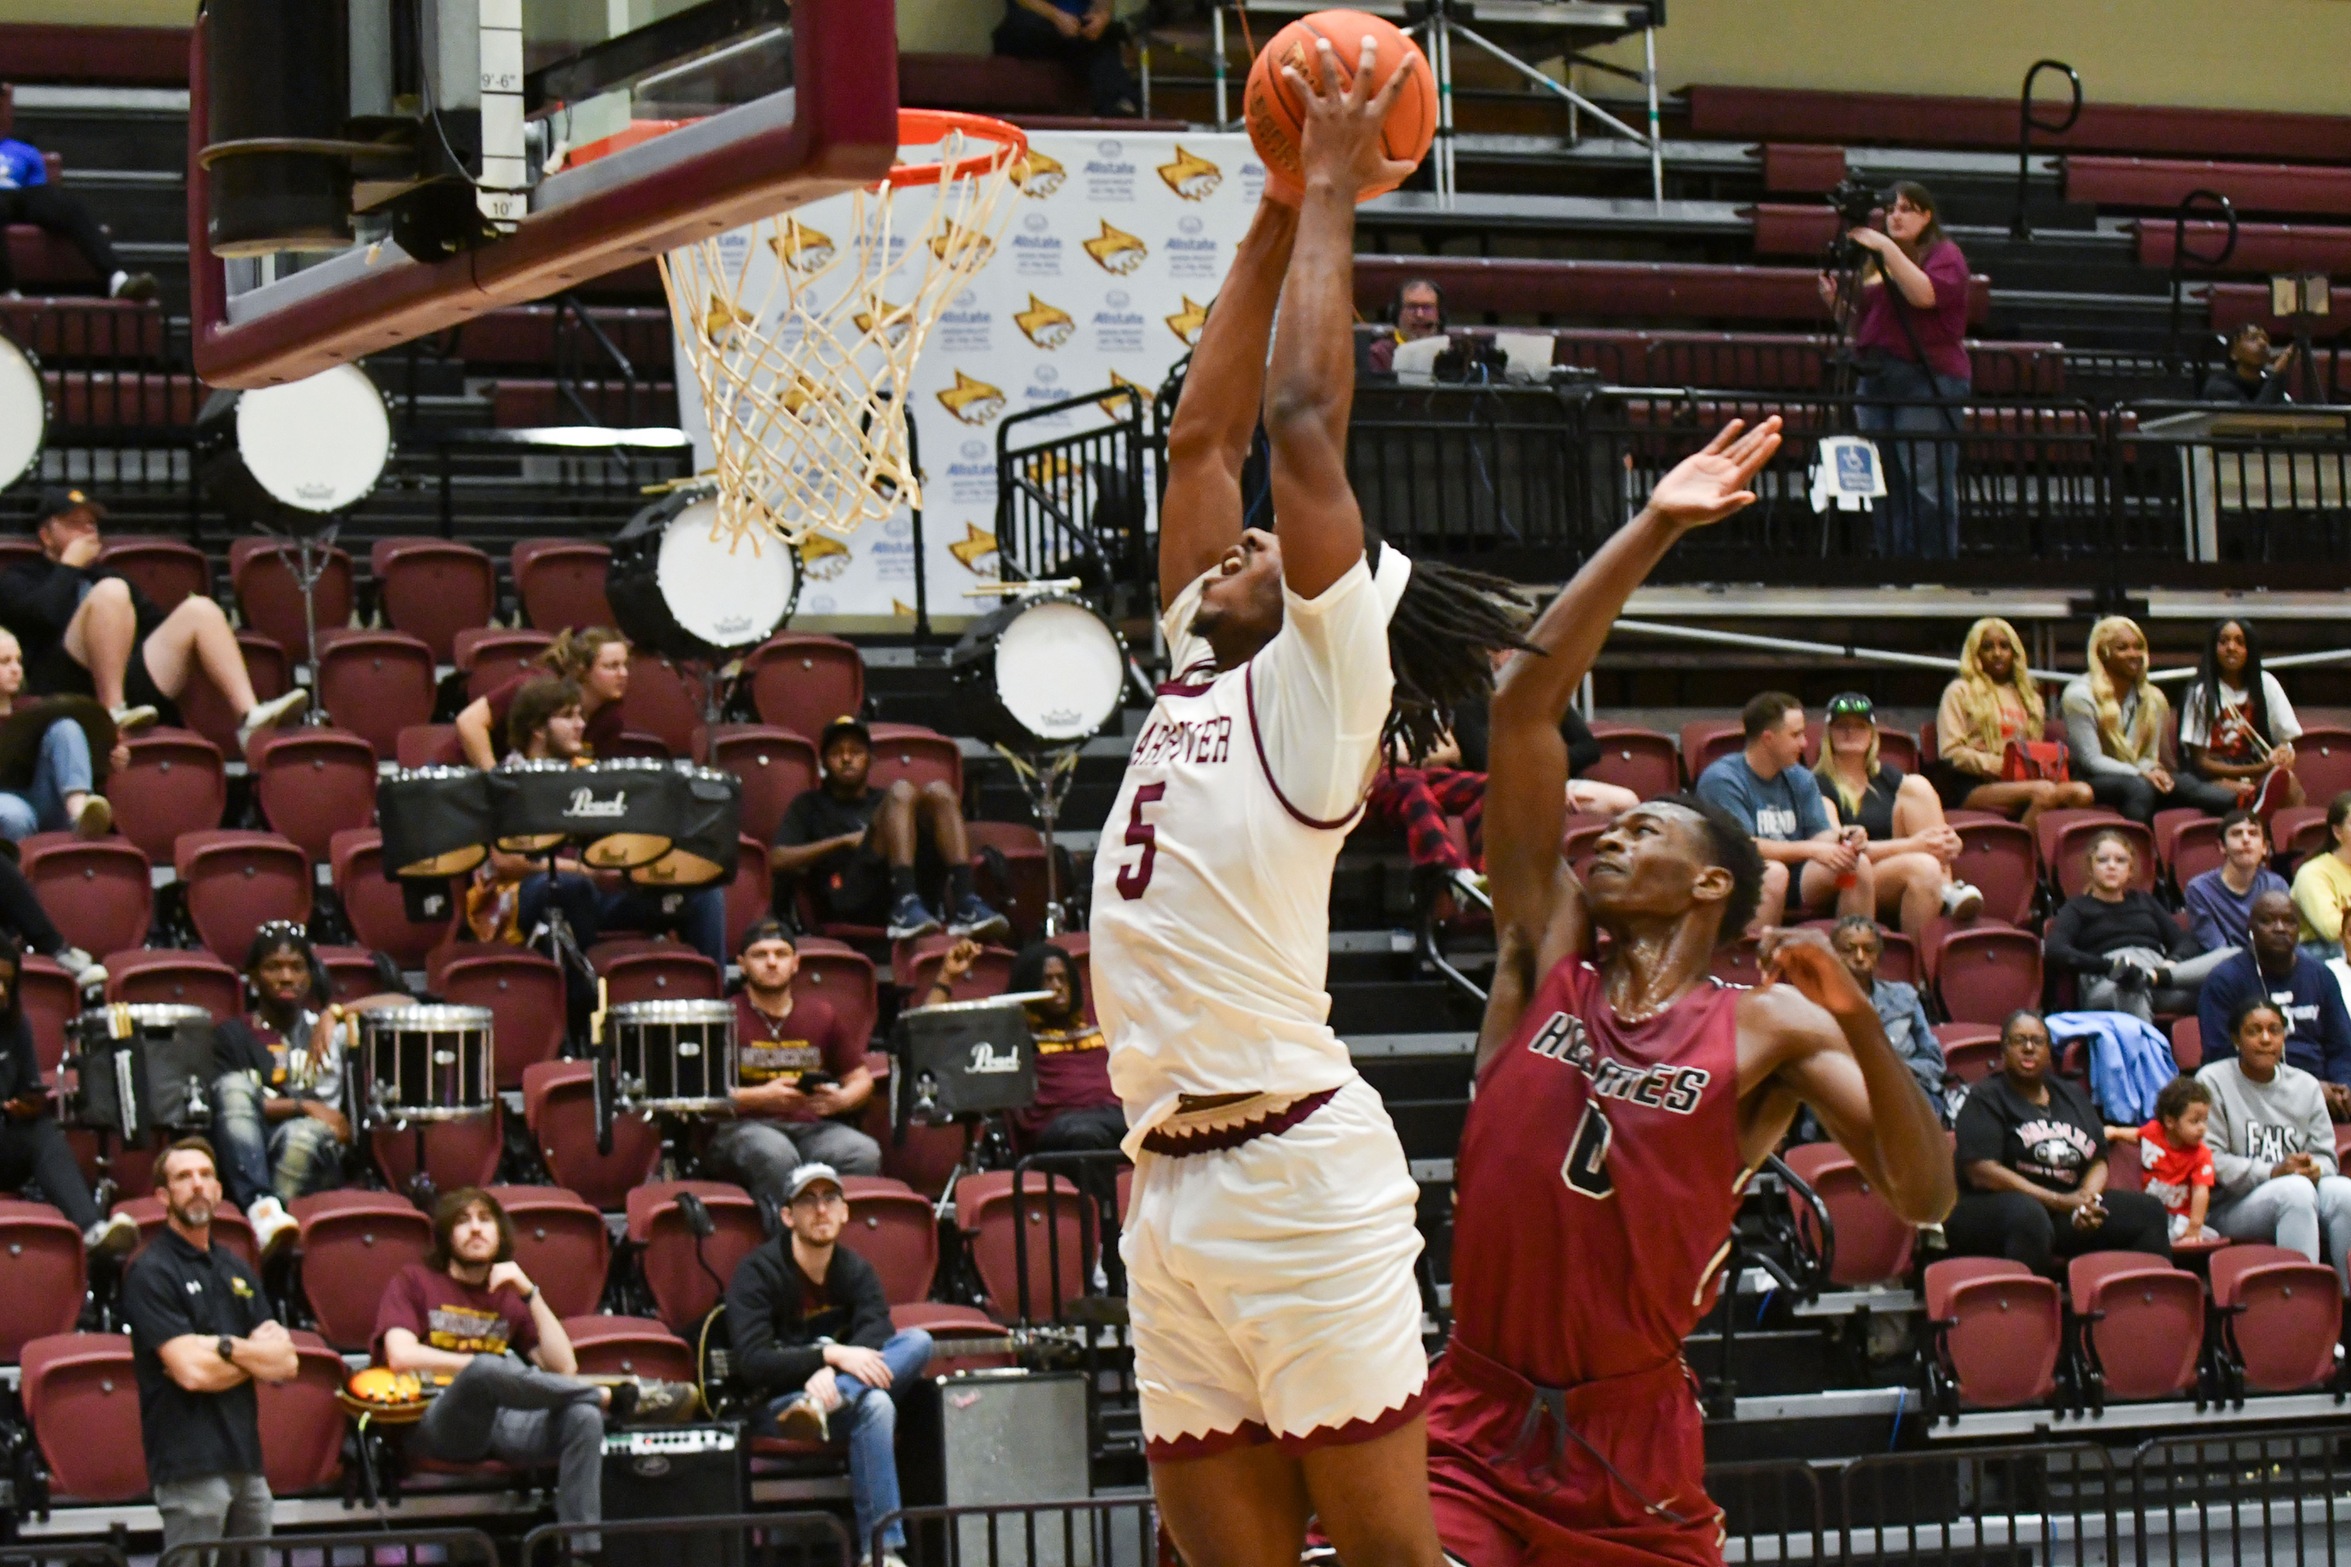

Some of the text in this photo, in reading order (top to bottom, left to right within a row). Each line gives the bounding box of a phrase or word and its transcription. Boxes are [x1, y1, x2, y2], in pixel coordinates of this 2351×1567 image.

[481, 73, 516, 88] 9'-6"
[1083, 161, 1136, 175] Allstate
[493, 202, 513, 216] 10'
[1012, 235, 1062, 249] Allstate
[1164, 237, 1217, 251] Allstate
[1093, 311, 1144, 325] Allstate
[563, 786, 628, 818] Pearl
[1116, 780, 1167, 901] 5
[964, 1041, 1021, 1074] Pearl
[1560, 1097, 1614, 1201] 0
